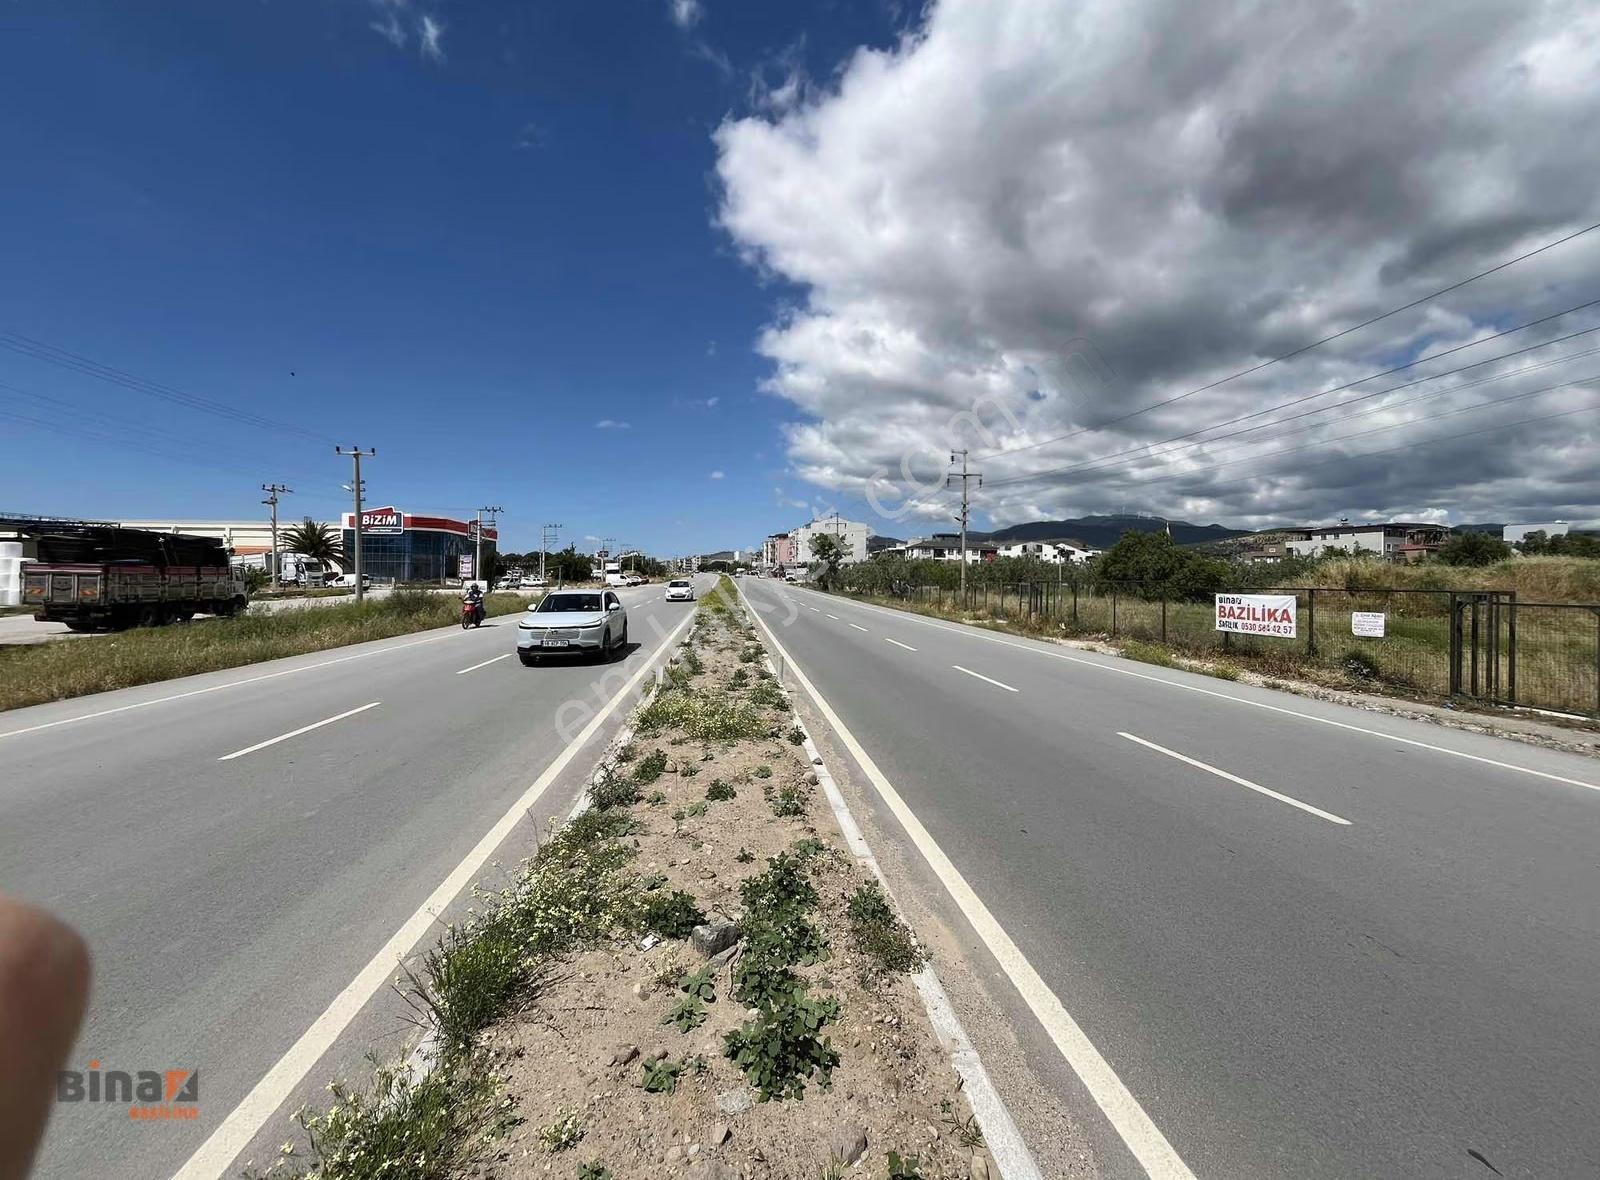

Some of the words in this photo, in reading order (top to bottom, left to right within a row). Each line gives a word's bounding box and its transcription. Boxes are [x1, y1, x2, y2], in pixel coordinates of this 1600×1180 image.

[1218, 604, 1293, 624] BAZİLİKA
[1241, 622, 1256, 632] 0530
[1283, 625, 1293, 635] 57
